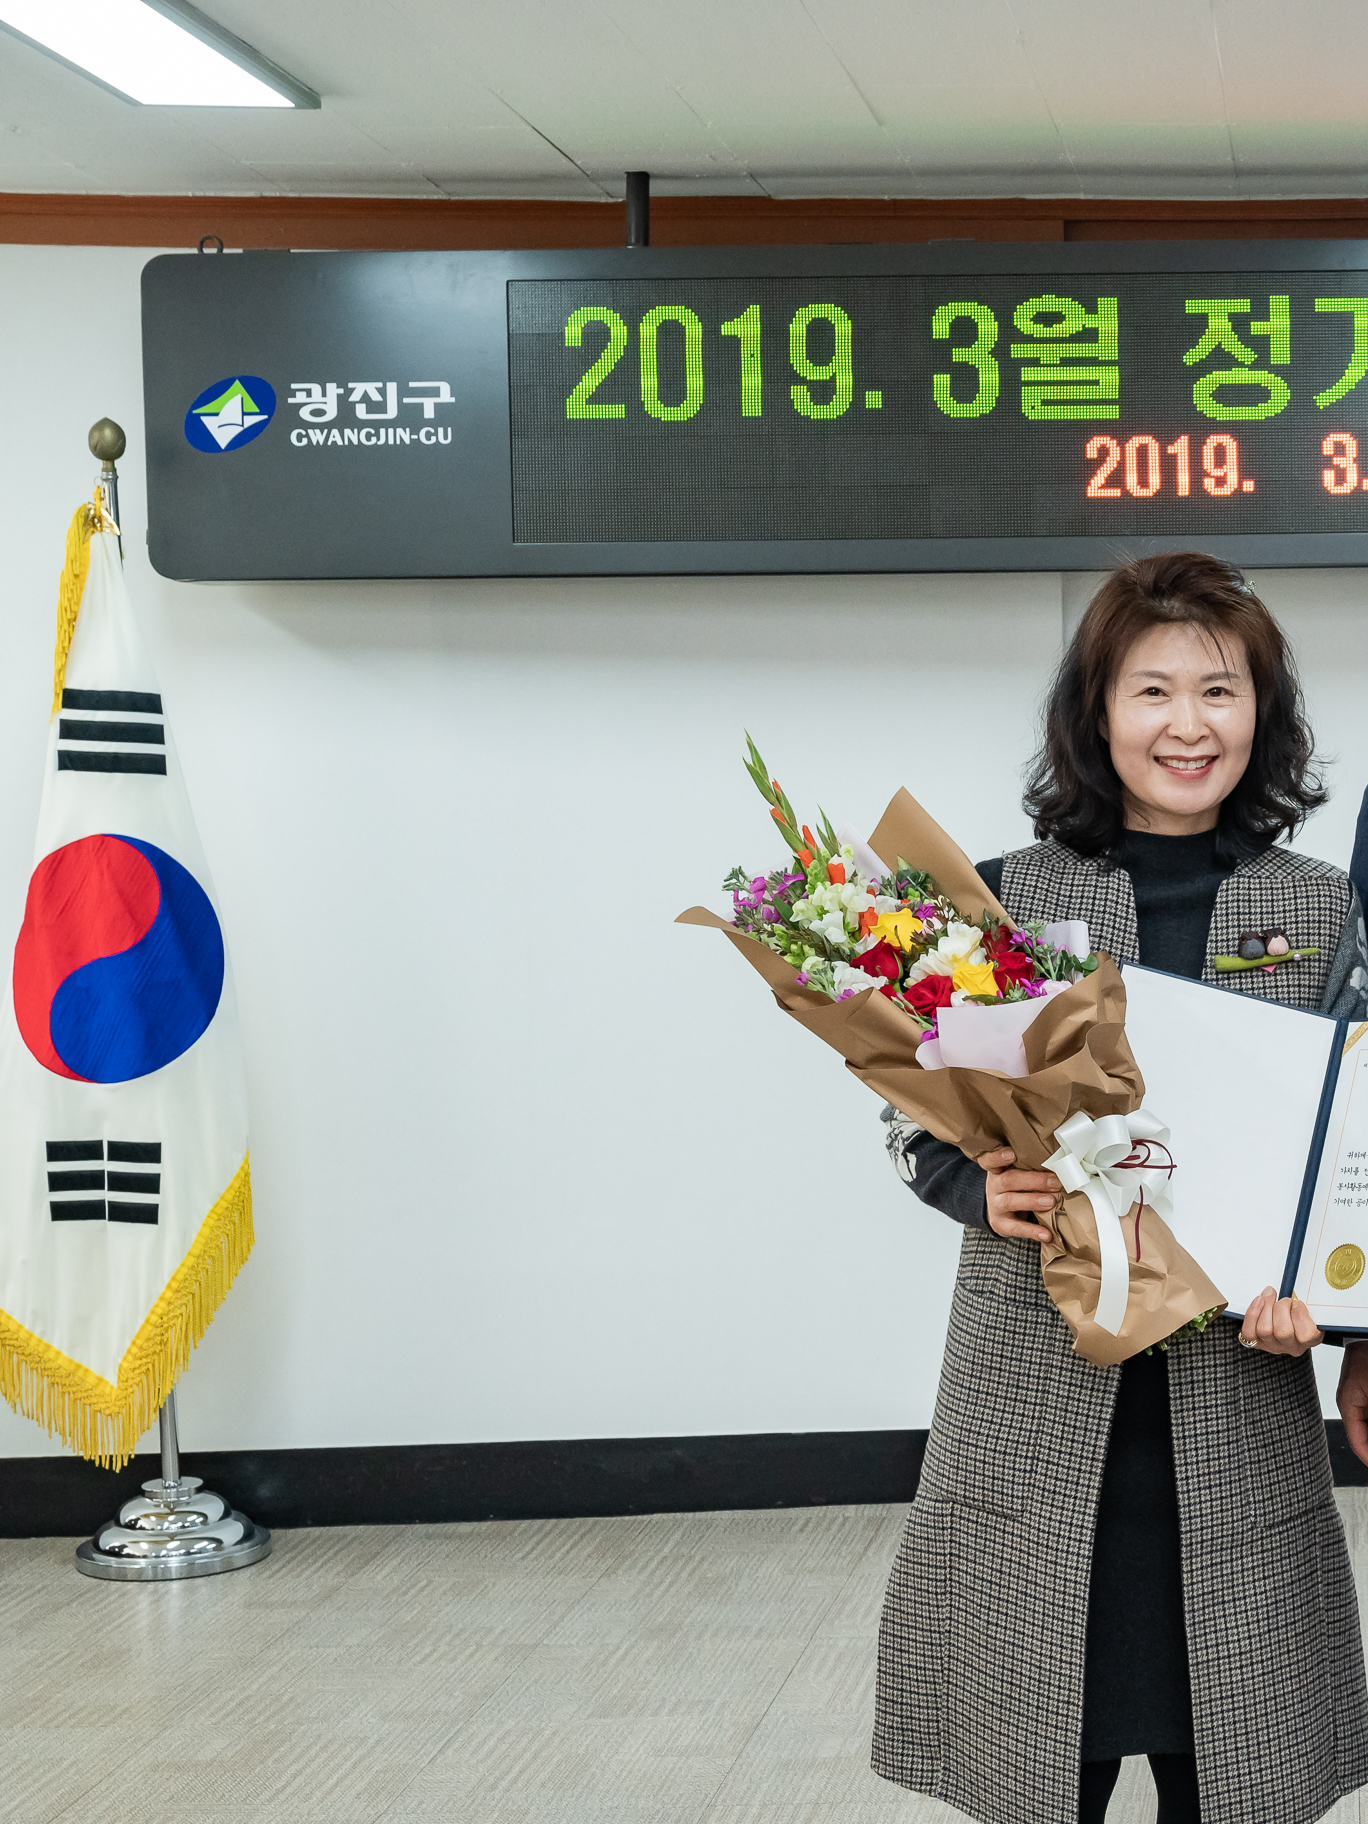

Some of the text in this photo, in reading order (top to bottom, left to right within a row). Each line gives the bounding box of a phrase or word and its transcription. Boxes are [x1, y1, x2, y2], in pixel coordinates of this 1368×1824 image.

[565, 304, 882, 421] 2019.
[932, 295, 1119, 420] 3월
[288, 381, 455, 422] 광진구
[291, 427, 451, 446] GWANGJIN-GU
[1085, 434, 1255, 498] 2019.
[1340, 1166, 1360, 1177] 가치를
[1336, 1181, 1368, 1192] 봉사활동에
[1333, 1197, 1354, 1208] 기여한
[1355, 1198, 1368, 1208] 공이
